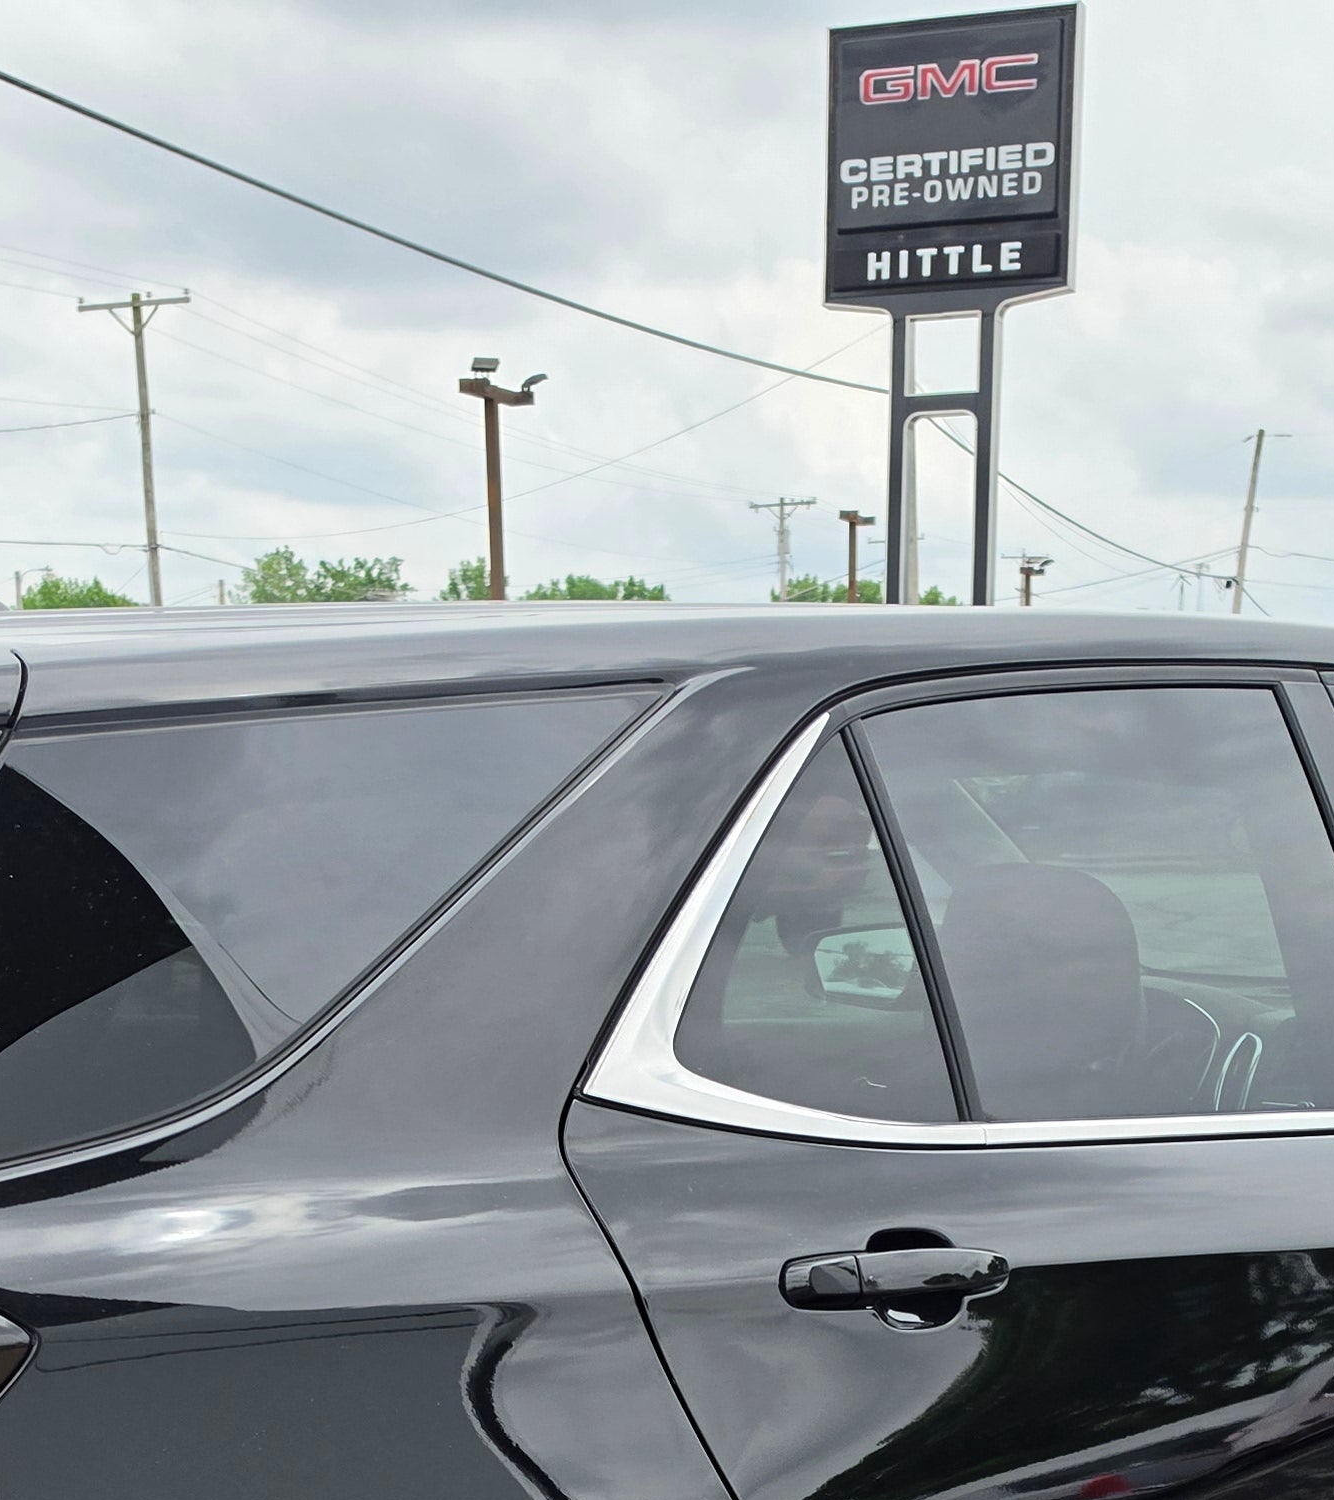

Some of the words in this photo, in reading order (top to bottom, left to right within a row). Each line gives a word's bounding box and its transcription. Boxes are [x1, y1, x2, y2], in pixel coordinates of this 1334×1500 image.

[859, 53, 1039, 105] GMC
[839, 141, 1056, 184] CERTIFIED
[851, 171, 1043, 210] PRE-OWNED
[867, 241, 1023, 281] HITTLE
